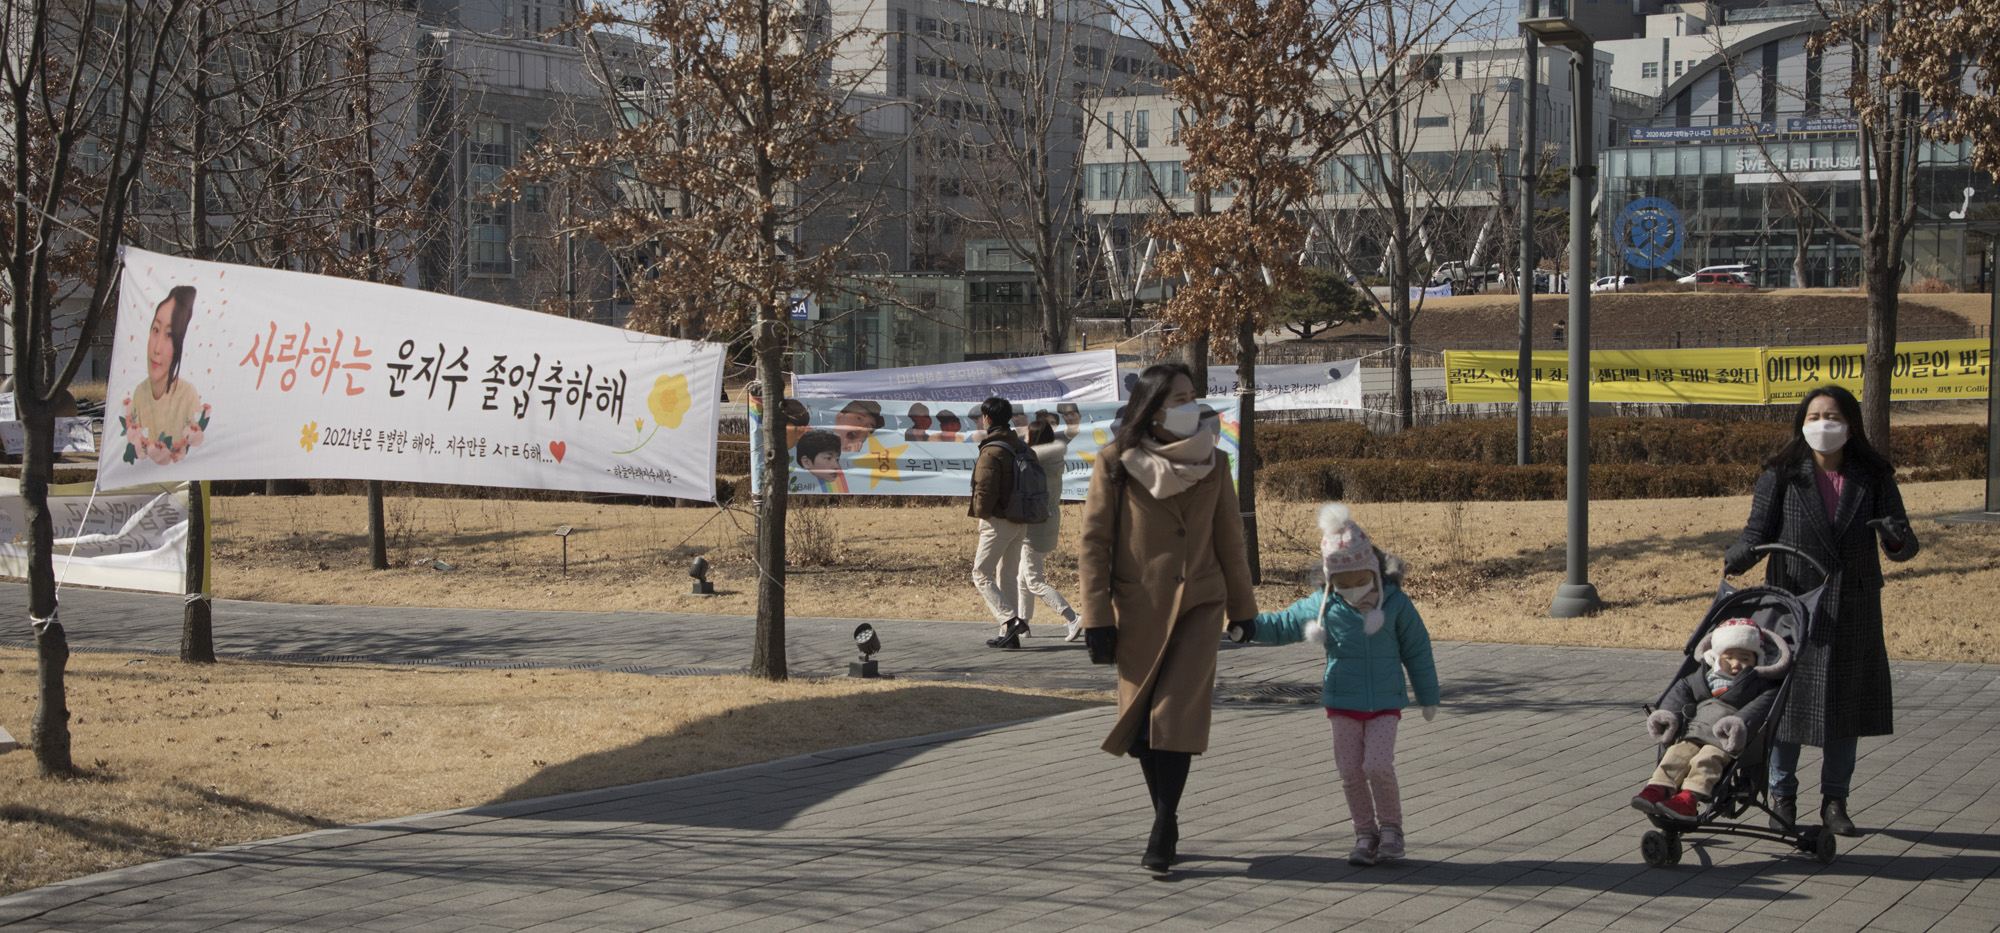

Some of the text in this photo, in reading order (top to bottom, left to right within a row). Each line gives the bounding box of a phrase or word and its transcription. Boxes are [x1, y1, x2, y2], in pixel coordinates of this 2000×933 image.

[239, 320, 627, 425] 사랑하는 윤지수 졸업축하해
[1449, 367, 1494, 385] 콜린스,
[1715, 367, 1760, 383] 좋았다
[1767, 354, 1820, 382] 이디엇
[322, 427, 373, 452] 2021년은
[376, 429, 408, 454] 특별한
[446, 436, 487, 458] 지수만을
